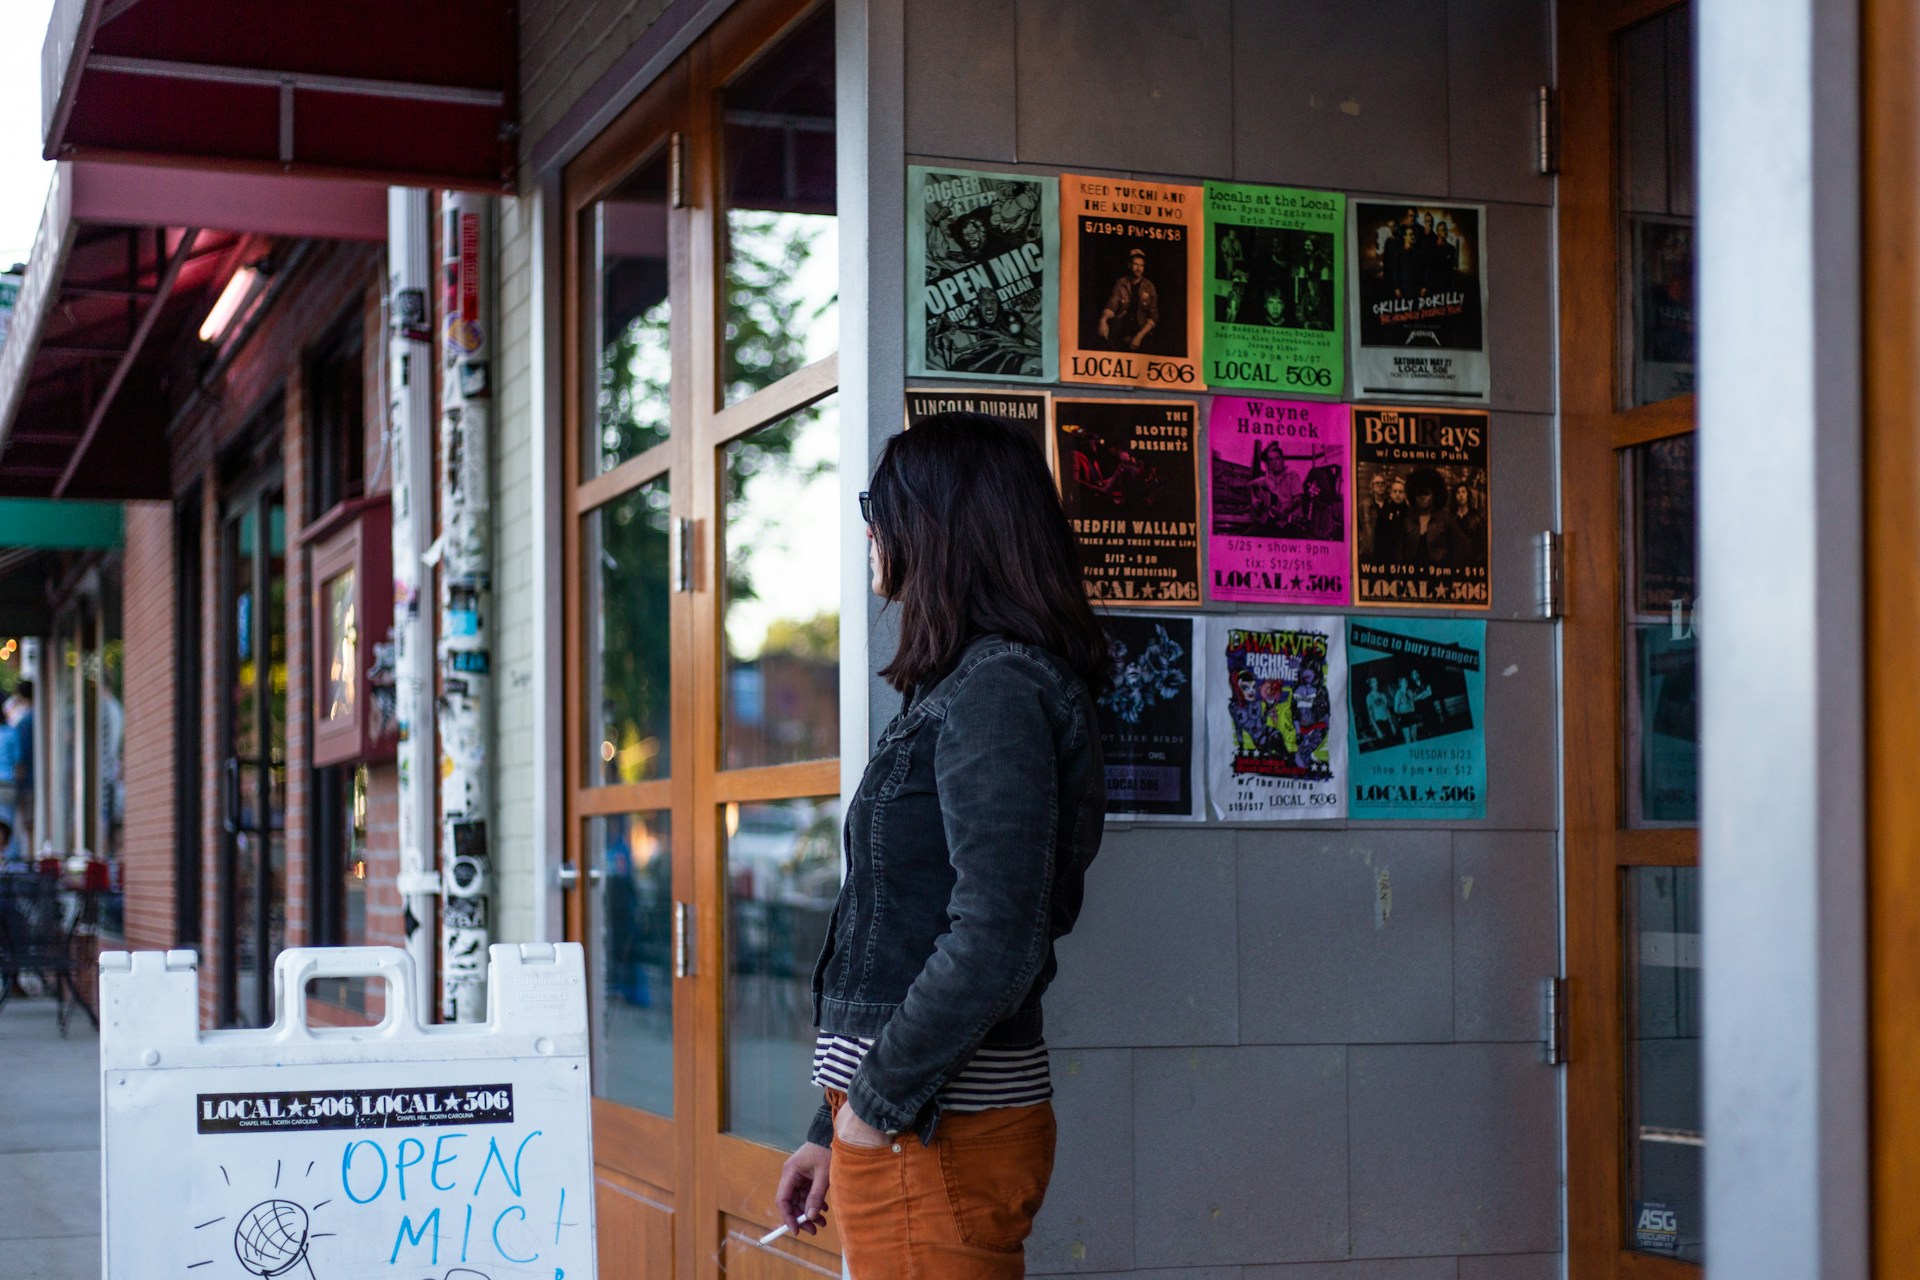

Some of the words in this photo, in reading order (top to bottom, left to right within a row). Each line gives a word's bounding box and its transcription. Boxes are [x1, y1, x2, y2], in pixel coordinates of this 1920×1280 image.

[925, 177, 980, 203] BIGGER
[1080, 183, 1110, 196] REED
[1115, 186, 1158, 200] TURCHI
[1162, 192, 1186, 203] AND
[1209, 187, 1252, 203] Locals
[1256, 193, 1271, 205] at
[1275, 195, 1297, 207] the
[1301, 196, 1337, 211] Local
[1084, 199, 1107, 212] THE
[1112, 203, 1152, 215] KUDZU
[1158, 207, 1183, 219] TWO
[1211, 202, 1236, 212] feat.
[1241, 204, 1266, 215] Ryan
[1271, 206, 1312, 218] Higgins
[1316, 212, 1334, 220] and
[1240, 215, 1264, 225] Eric
[1268, 217, 1306, 229] Trundy
[925, 264, 993, 314] OPEN
[988, 243, 1043, 287] MIC
[996, 277, 1035, 302] DYLAN
[1270, 353, 1282, 362] pm
[1393, 357, 1428, 366] SATURDAY
[1430, 358, 1444, 366] MAY
[1072, 357, 1139, 379] LOCAL
[1147, 361, 1195, 383] 506
[1214, 361, 1278, 383] LOCAL
[1286, 365, 1331, 387] 506
[1398, 365, 1428, 373] LOCAL
[915, 399, 974, 416] LINCOLN
[981, 401, 1039, 419] DURHAM
[1166, 411, 1188, 421] THE
[1246, 402, 1309, 422] Wayne
[1382, 413, 1398, 423] the
[1135, 425, 1188, 437] BLOTTER
[1237, 418, 1319, 438] Hancock
[1364, 416, 1480, 452] BellRays
[1130, 440, 1188, 451] PRESENTS
[1376, 449, 1389, 457] w/
[1393, 448, 1436, 460] Cosmic
[1441, 450, 1469, 460] Punk
[1073, 519, 1126, 534] REDFIN
[1132, 521, 1196, 536] WALLABY
[1107, 538, 1124, 546] AND
[1154, 539, 1176, 547] WEAK
[1228, 540, 1252, 552] 5/25
[1267, 542, 1301, 554] show:
[1306, 544, 1329, 556] 9pm
[1105, 553, 1126, 563] 5/12
[1137, 554, 1143, 564] 9
[1145, 556, 1158, 565] pm
[1245, 557, 1265, 569] tix:
[1084, 566, 1104, 576] Free
[1108, 567, 1120, 576] w/
[1123, 567, 1177, 578] Membership
[1361, 563, 1385, 574] Wed
[1390, 564, 1415, 575] 5/10
[1428, 565, 1451, 577] 9pm
[1214, 570, 1288, 590] LOCAL
[1305, 574, 1342, 592] 506
[1082, 580, 1139, 599] OCAL
[1157, 581, 1197, 600] 506
[1361, 579, 1433, 598] LOCAL
[1450, 581, 1487, 600] 506
[1353, 630, 1359, 641] a
[1361, 631, 1389, 648] place
[1391, 637, 1402, 650] to
[1404, 639, 1430, 657] bury
[1431, 646, 1479, 665] strangers
[1246, 652, 1289, 668] RICHIE
[1254, 666, 1299, 681] RAMONE
[1409, 749, 1447, 759] TUESDAY
[1450, 749, 1472, 760] 5/23
[1401, 764, 1408, 775] 9
[1410, 767, 1425, 777] pm
[1454, 764, 1472, 776] $12
[1107, 778, 1138, 791] LOCAL
[1238, 791, 1254, 800] 7/8
[1270, 794, 1306, 807] LOCAL
[1309, 793, 1337, 806] 506
[1356, 784, 1423, 801] LOCAL
[1440, 785, 1475, 802] 506
[1228, 802, 1264, 811] $15/$17
[202, 1098, 287, 1120] LOCAL
[307, 1095, 354, 1117] 506
[360, 1093, 442, 1116] LOCAL
[463, 1090, 509, 1111] 506
[342, 1130, 542, 1204] OPEN
[1638, 1209, 1677, 1231] ASG
[388, 1187, 567, 1280] MIC!
